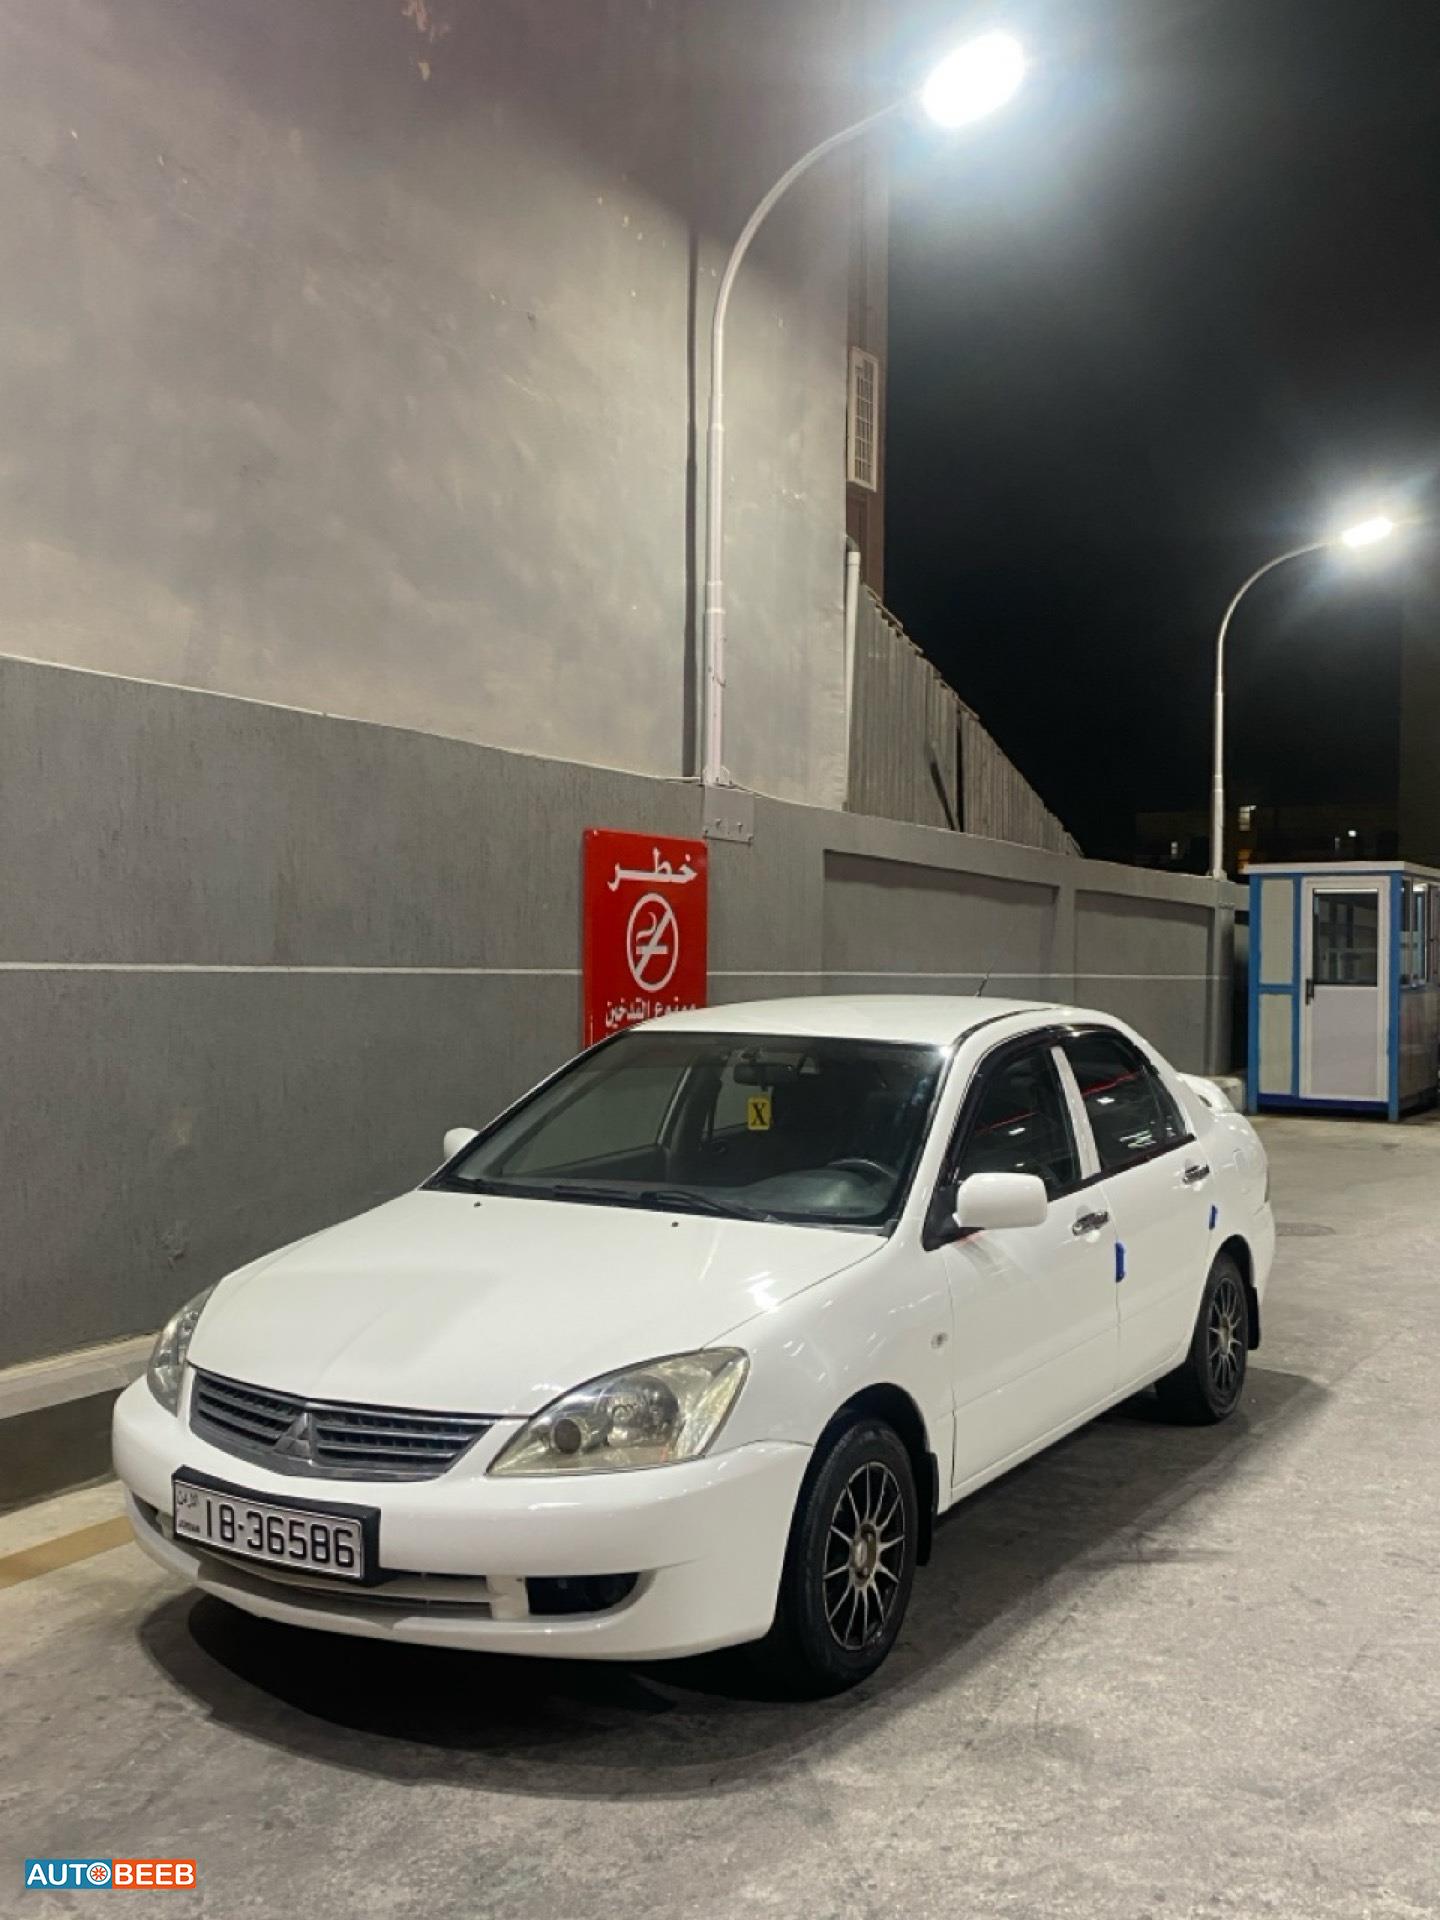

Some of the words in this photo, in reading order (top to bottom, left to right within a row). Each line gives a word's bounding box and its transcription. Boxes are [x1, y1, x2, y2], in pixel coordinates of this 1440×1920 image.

[607, 847, 698, 892] خطر
[751, 1102, 769, 1126] X
[206, 1499, 355, 1568] 18-36586
